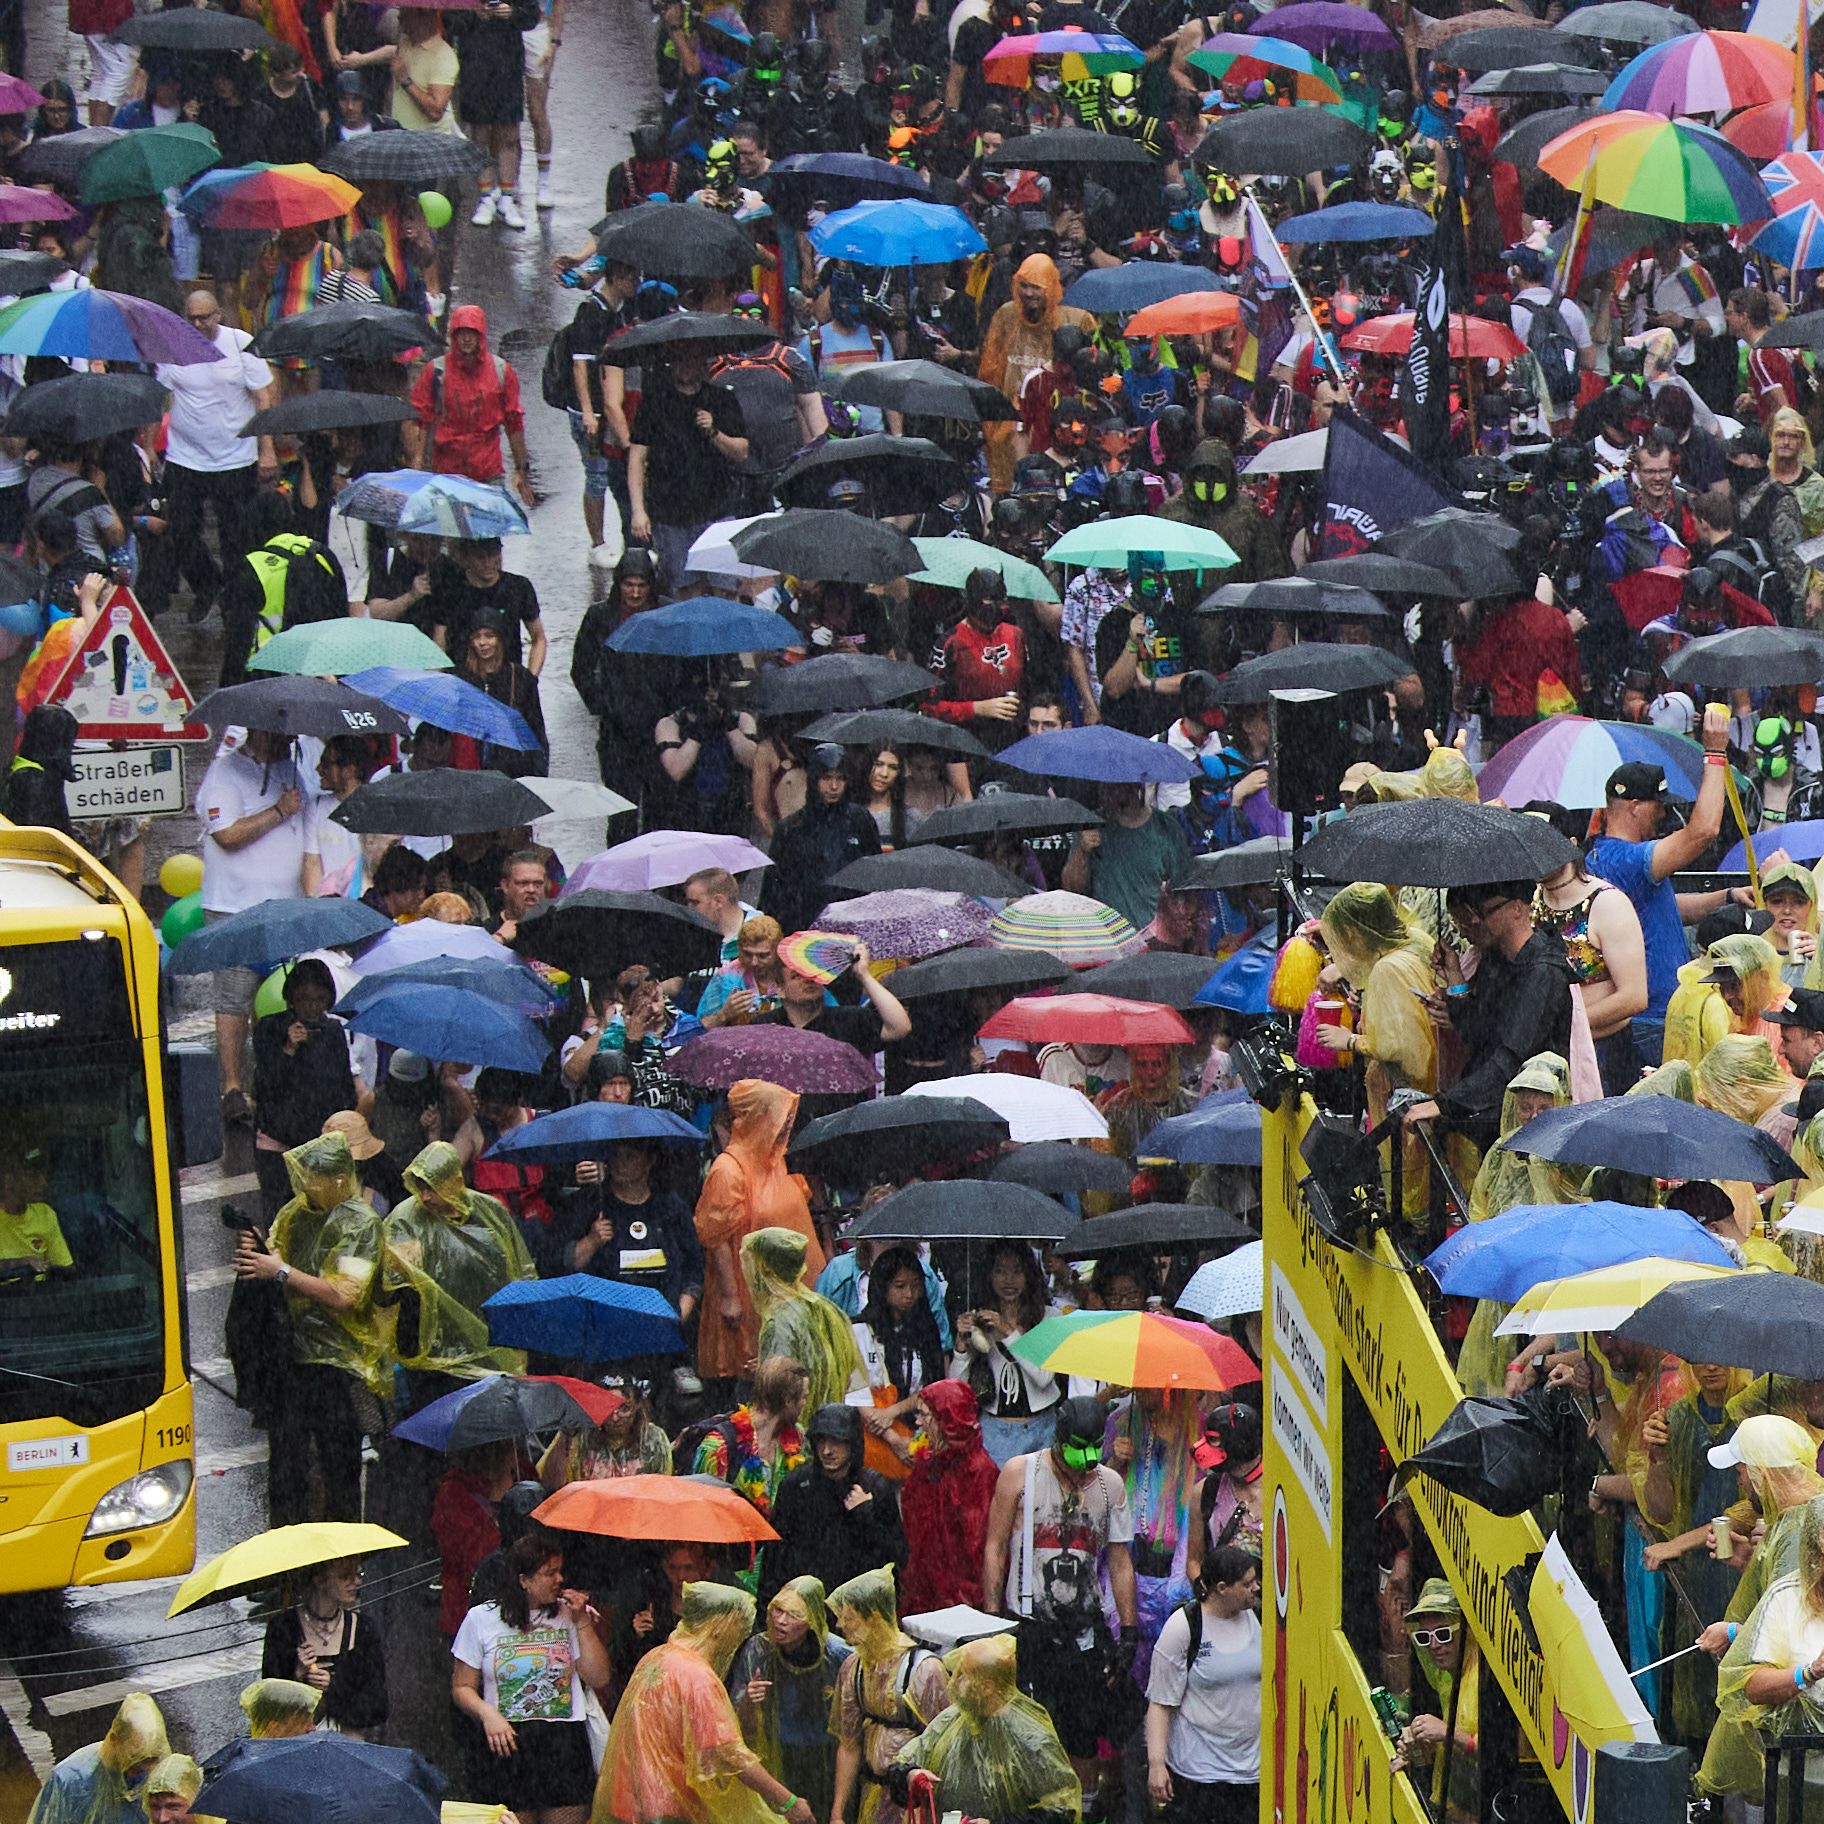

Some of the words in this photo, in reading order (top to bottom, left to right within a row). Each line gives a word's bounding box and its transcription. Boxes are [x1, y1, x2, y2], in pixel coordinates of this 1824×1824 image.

[341, 709, 378, 728] N26
[75, 782, 165, 808] schäden
[156, 1423, 191, 1448] 1190
[17, 1447, 58, 1462] BERLIN
[1354, 1303, 1384, 1410] stark
[1473, 1555, 1500, 1645] und
